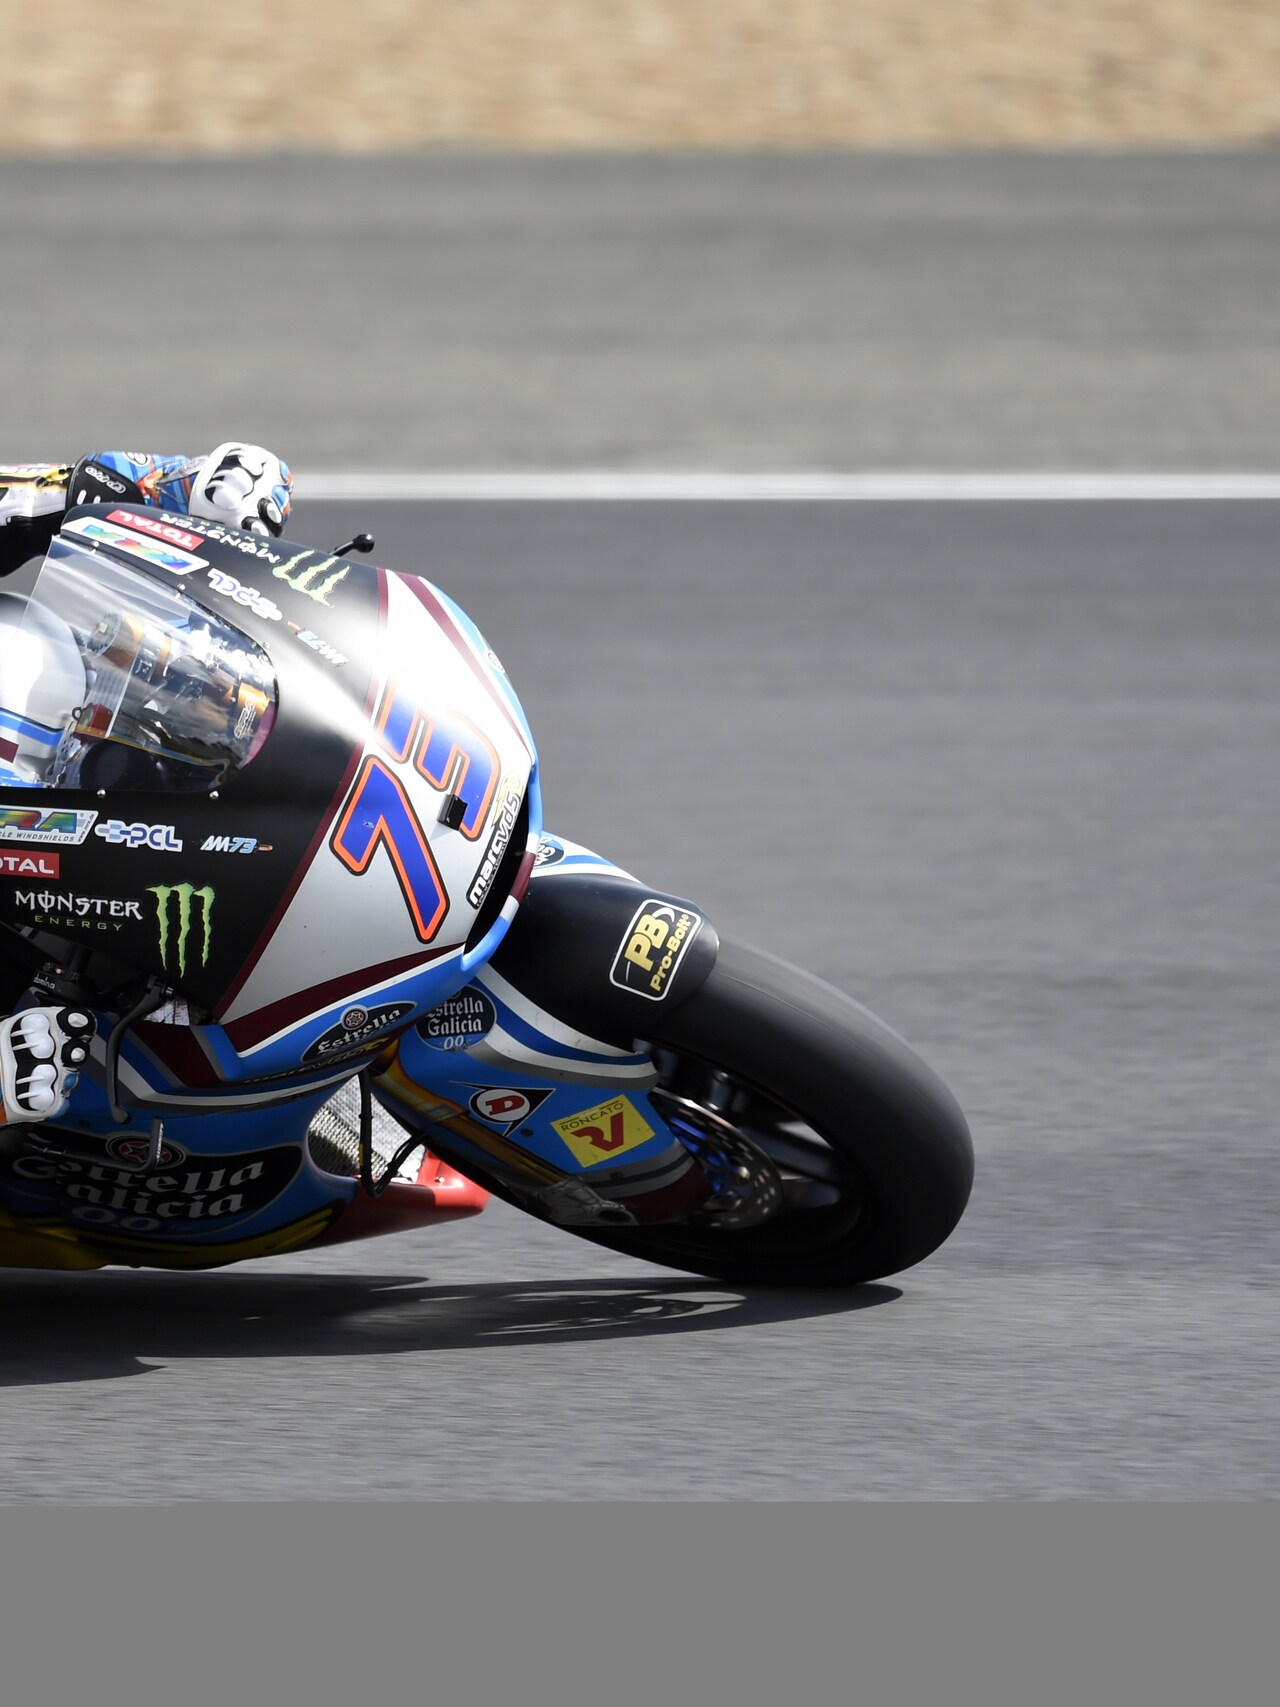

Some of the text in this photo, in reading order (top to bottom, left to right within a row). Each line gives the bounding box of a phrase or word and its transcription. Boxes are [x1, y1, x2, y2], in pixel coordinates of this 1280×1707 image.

[119, 511, 194, 548] TOTAL
[159, 513, 282, 564] MONSTER
[329, 672, 502, 945] 73
[16, 832, 75, 843] WINDSHIELDS
[14, 889, 144, 921] MONSTER
[34, 915, 124, 932] ENERGY
[624, 914, 670, 972] PB
[649, 915, 692, 992] Pro-Bolt
[317, 1008, 402, 1056] Estrella
[427, 1014, 483, 1036] Galicia
[560, 1102, 625, 1132] RONCATO
